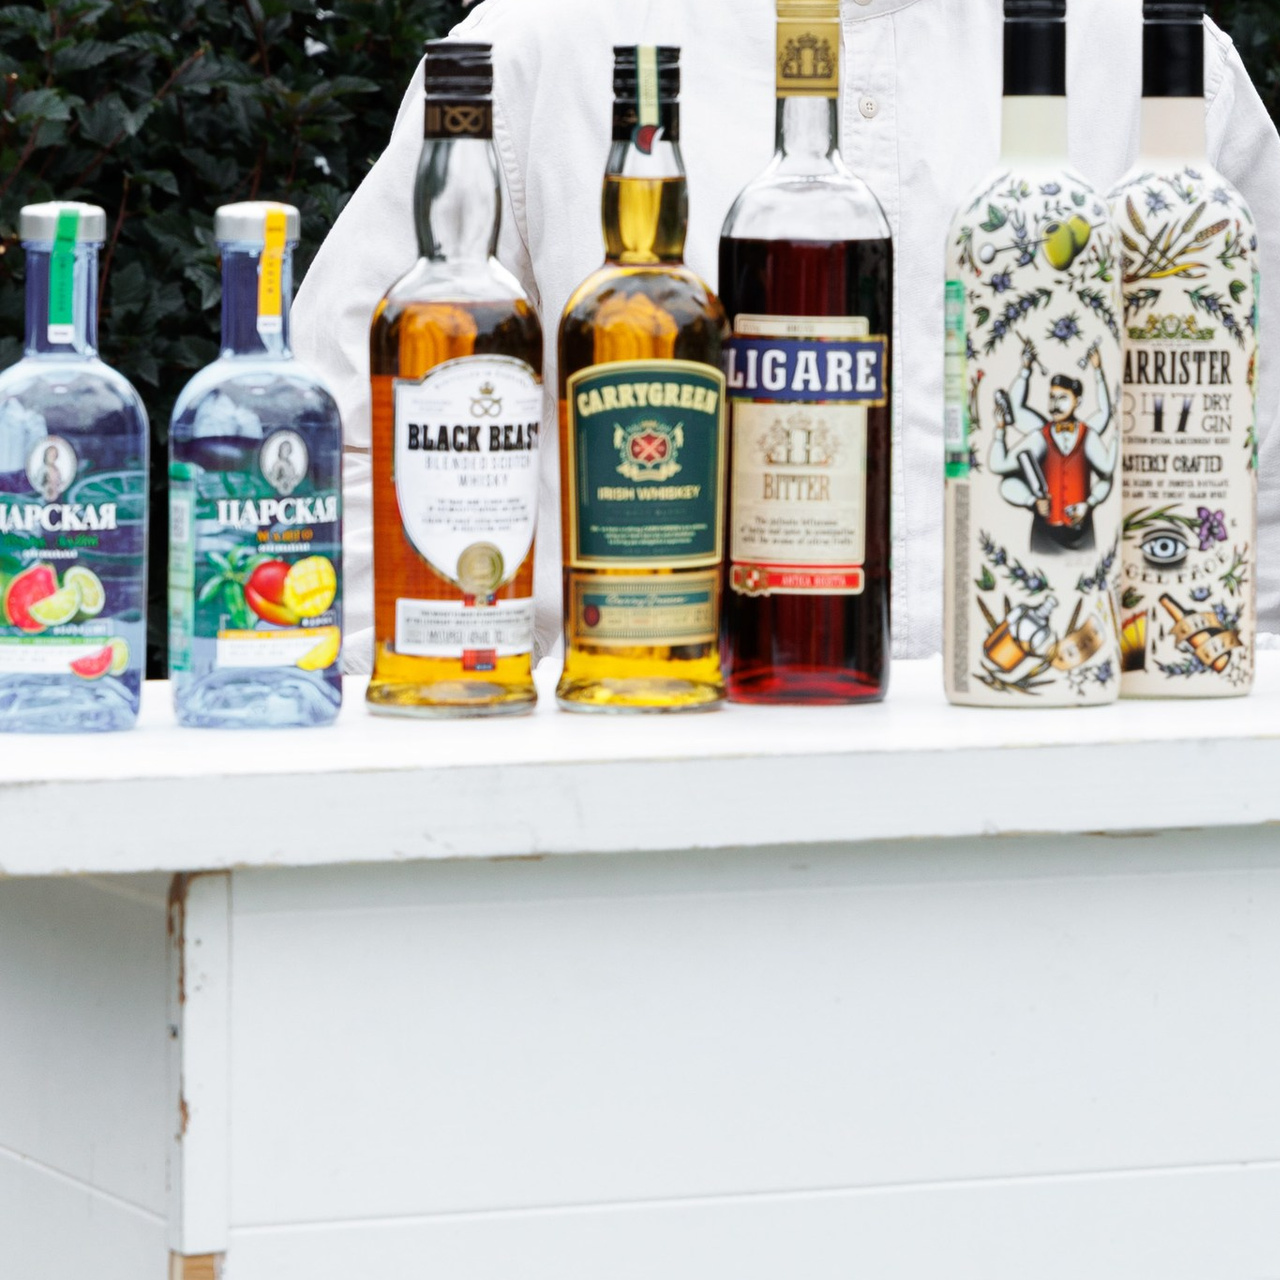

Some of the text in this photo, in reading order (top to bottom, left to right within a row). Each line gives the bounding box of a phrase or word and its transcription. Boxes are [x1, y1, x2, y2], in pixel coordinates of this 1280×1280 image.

[727, 348, 877, 392] LIGARE
[1123, 350, 1232, 385] ARRISTER
[577, 382, 719, 417] CARRYGREEN
[1202, 393, 1232, 411] DRY
[408, 423, 480, 452] BLACK
[1201, 415, 1232, 432] GIN
[1122, 455, 1168, 472] ASTERLY
[597, 485, 700, 501] IRISH WHISKEY
[763, 473, 830, 501] BITTER
[217, 495, 338, 529] ЦАРСКАЯ
